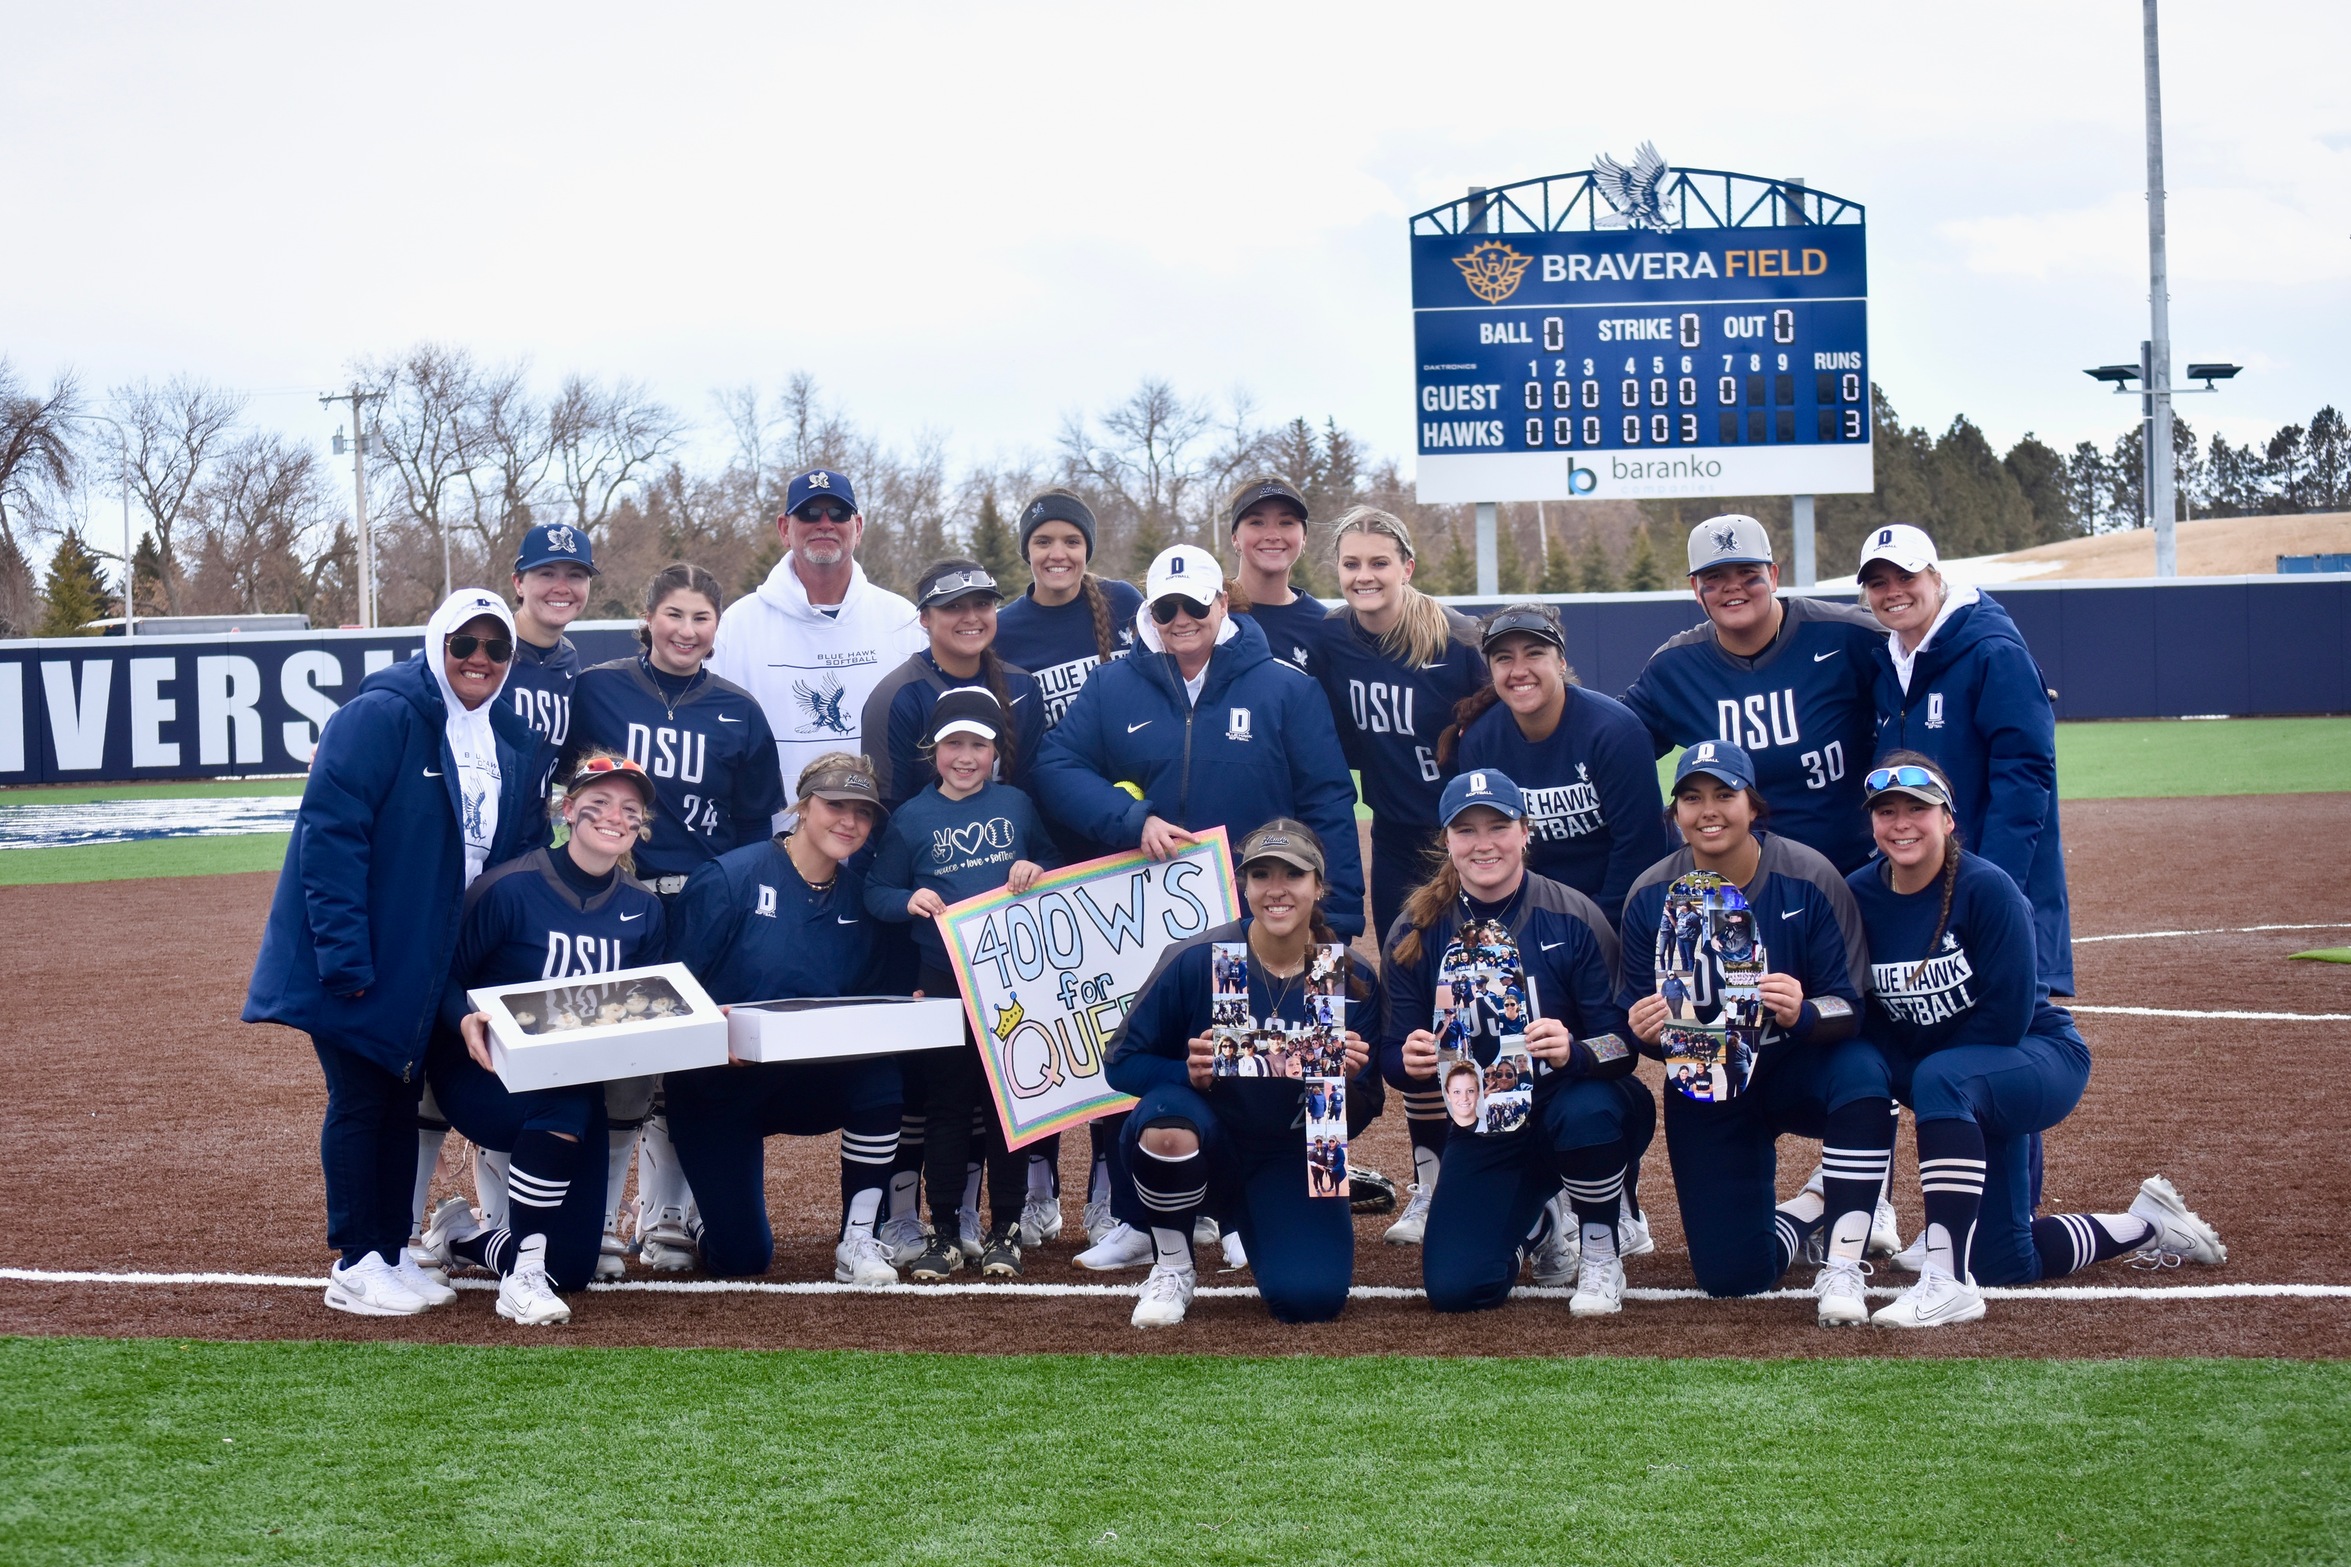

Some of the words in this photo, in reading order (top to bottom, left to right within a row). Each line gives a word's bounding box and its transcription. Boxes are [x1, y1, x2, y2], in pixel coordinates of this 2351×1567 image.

[1542, 252, 1718, 282] BRAVERA
[1725, 248, 1828, 278] FIELD
[1480, 322, 1533, 344] BALL
[1543, 317, 1564, 351] 0
[1598, 318, 1672, 341] STRIKE
[1680, 313, 1700, 347] 0
[1723, 316, 1766, 339] OUT
[1774, 309, 1794, 343] 0
[1423, 363, 1477, 371] DAKTRONICS
[1529, 360, 1537, 377] 1
[1555, 359, 1566, 377] 2
[1583, 358, 1594, 376] 3
[1624, 357, 1636, 375] 4
[1653, 356, 1664, 374] 5
[1681, 356, 1692, 373] 6
[1722, 355, 1733, 372] 7
[1750, 354, 1761, 372] 8
[1777, 353, 1788, 371] 9
[1814, 352, 1861, 370] RUNS
[1422, 384, 1500, 411] GUEST
[1525, 382, 1542, 409] 0
[1554, 381, 1571, 408] 0
[1582, 380, 1599, 408] 0
[1622, 379, 1639, 407] 0
[1651, 378, 1668, 406] 0
[1679, 377, 1696, 405] 0
[1719, 376, 1736, 404] 0
[1843, 374, 1859, 401] 0
[1423, 420, 1504, 448] HAWKS
[1526, 418, 1543, 445] 0
[1555, 417, 1572, 445] 0
[1583, 416, 1600, 444] 0
[1623, 415, 1640, 443] 0
[1652, 414, 1669, 442] 0
[1682, 414, 1697, 441] 3
[1845, 410, 1860, 438] 3
[1612, 454, 1722, 480] baranko
[1620, 482, 1715, 495] companies
[1878, 529, 1893, 545] D
[1171, 557, 1185, 575] D
[817, 652, 844, 660] BLUE
[847, 649, 876, 658] HAWK
[825, 655, 878, 666] SOFTBALL
[1229, 707, 1251, 733] D
[1349, 679, 1415, 736] DSU
[1718, 688, 1799, 750] DSU
[1927, 692, 1944, 721] D
[627, 722, 706, 784] DSU
[1415, 745, 1440, 782] 6
[1697, 743, 1716, 759] D
[1801, 740, 1845, 790] 30
[1469, 773, 1487, 792] D
[683, 794, 718, 835] 24
[1537, 786, 1599, 815] HAWK
[1527, 810, 1607, 844] FTBALL
[966, 857, 984, 869] love
[757, 883, 777, 912] D
[541, 930, 621, 980] DSU
[1903, 955, 1967, 991] HAWK
[1057, 970, 1115, 1011] for
[1879, 984, 1978, 1026] OFTBALL
